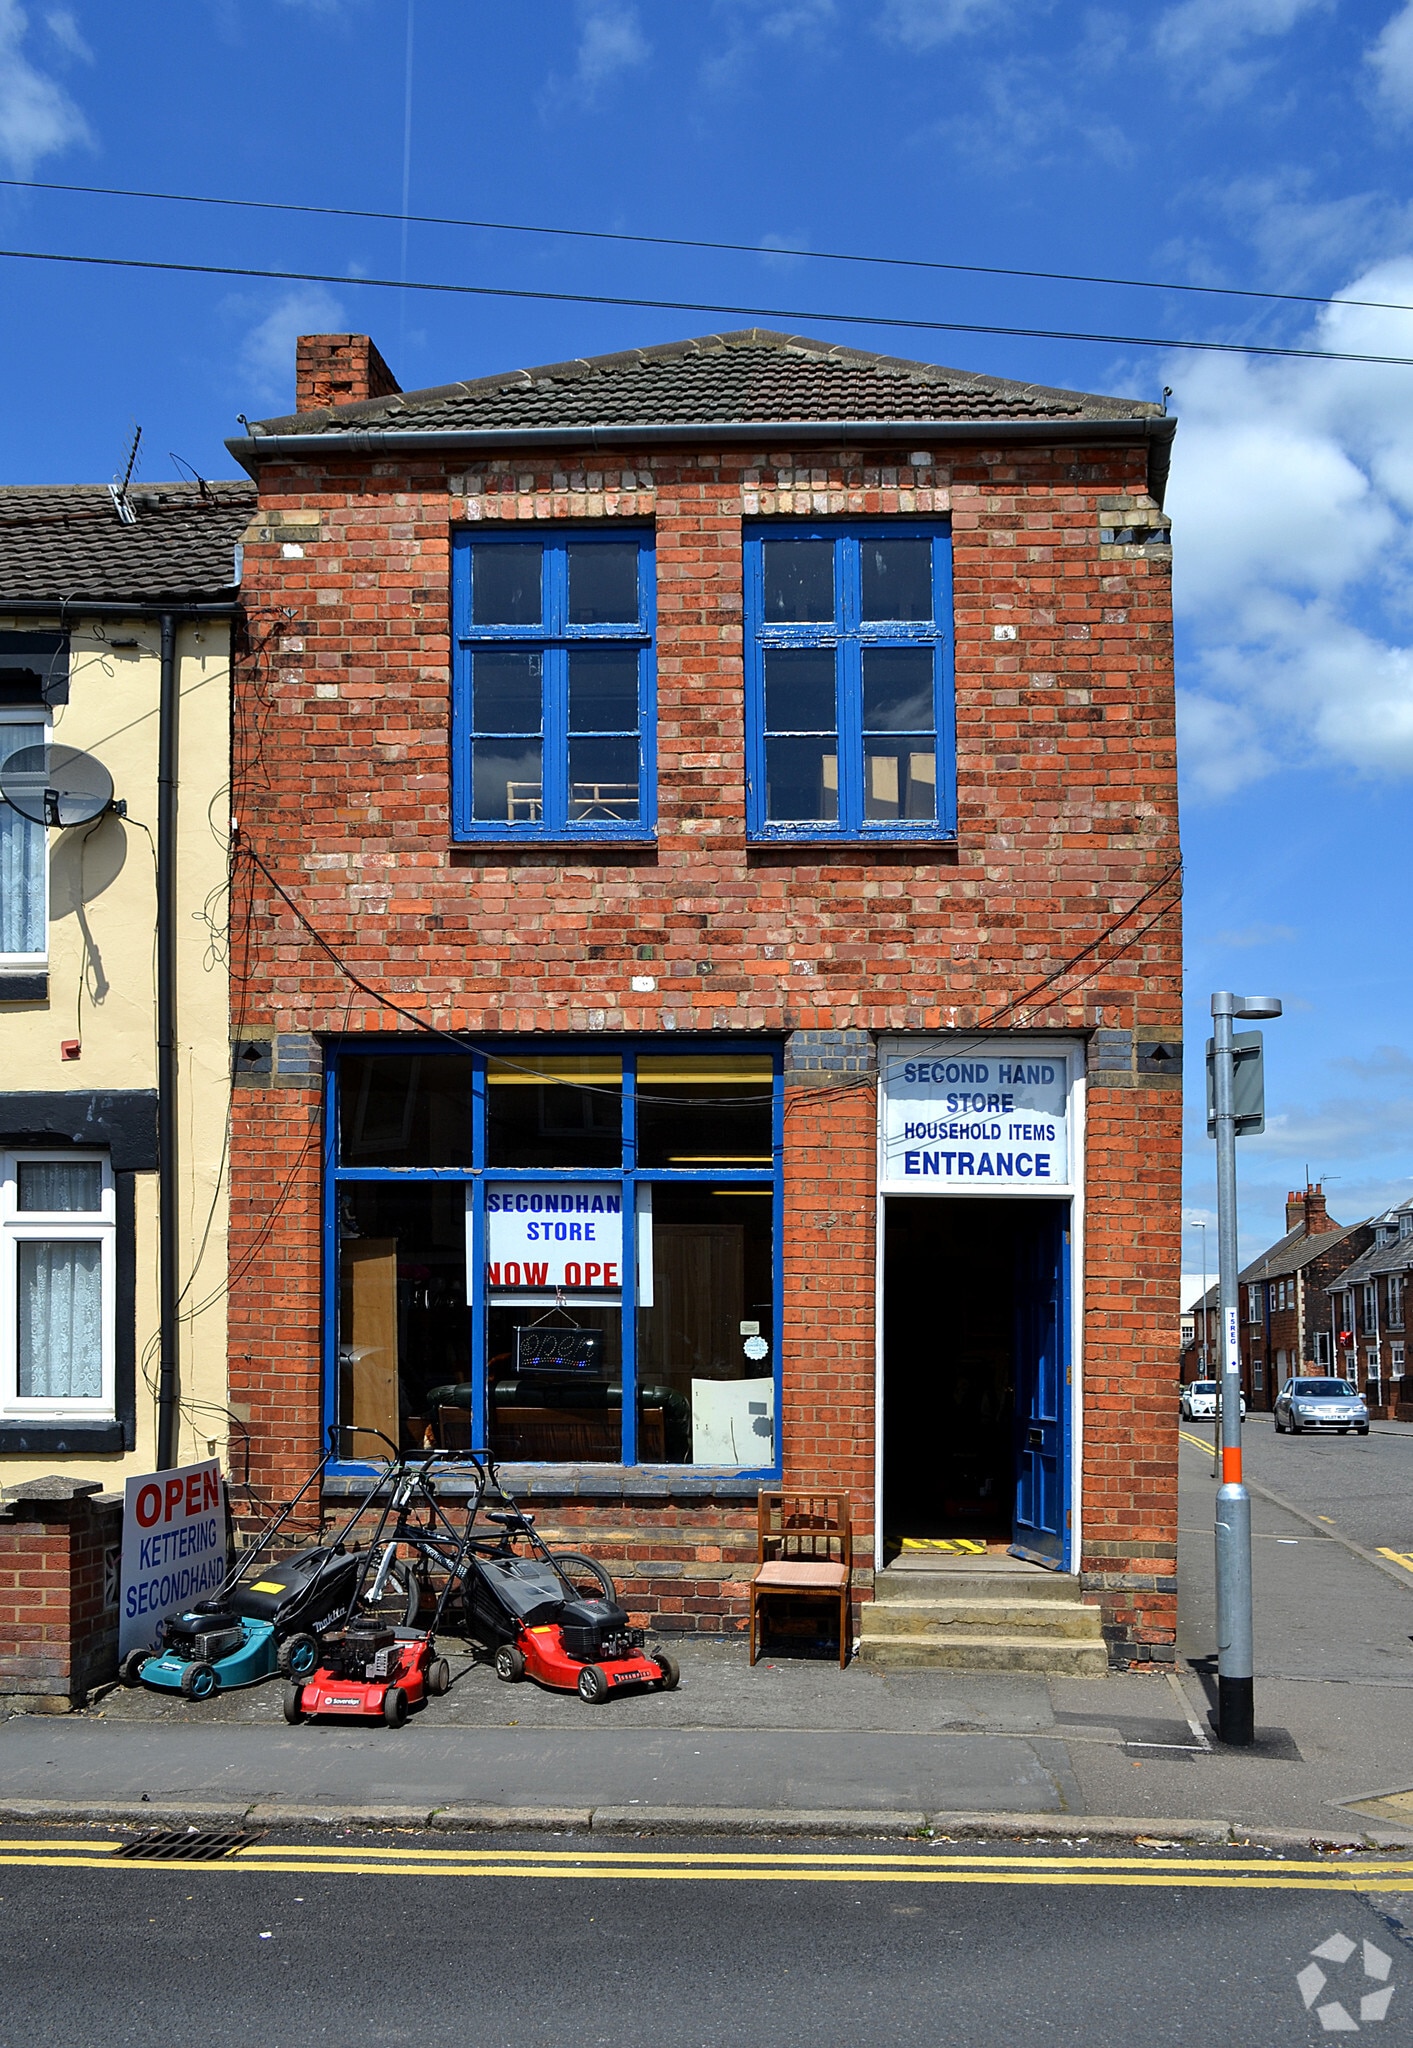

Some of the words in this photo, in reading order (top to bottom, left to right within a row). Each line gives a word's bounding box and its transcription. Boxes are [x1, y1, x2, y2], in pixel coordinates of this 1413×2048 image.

[904, 1063, 989, 1083] SECOND
[999, 1064, 1055, 1084] HAND
[946, 1093, 1014, 1112] STORE
[904, 1122, 1001, 1139] HOUSEHOLD
[1009, 1124, 1056, 1141] ITEMS
[904, 1151, 1051, 1176] ENTRANCE
[487, 1193, 620, 1213] SECONDHAN
[527, 1222, 595, 1240] STORE
[485, 1261, 549, 1286] NOW
[564, 1261, 618, 1286] OPE
[135, 1467, 219, 1528] OPEN
[139, 1518, 217, 1571] KETTERING
[125, 1556, 224, 1619] SECONDHAND
